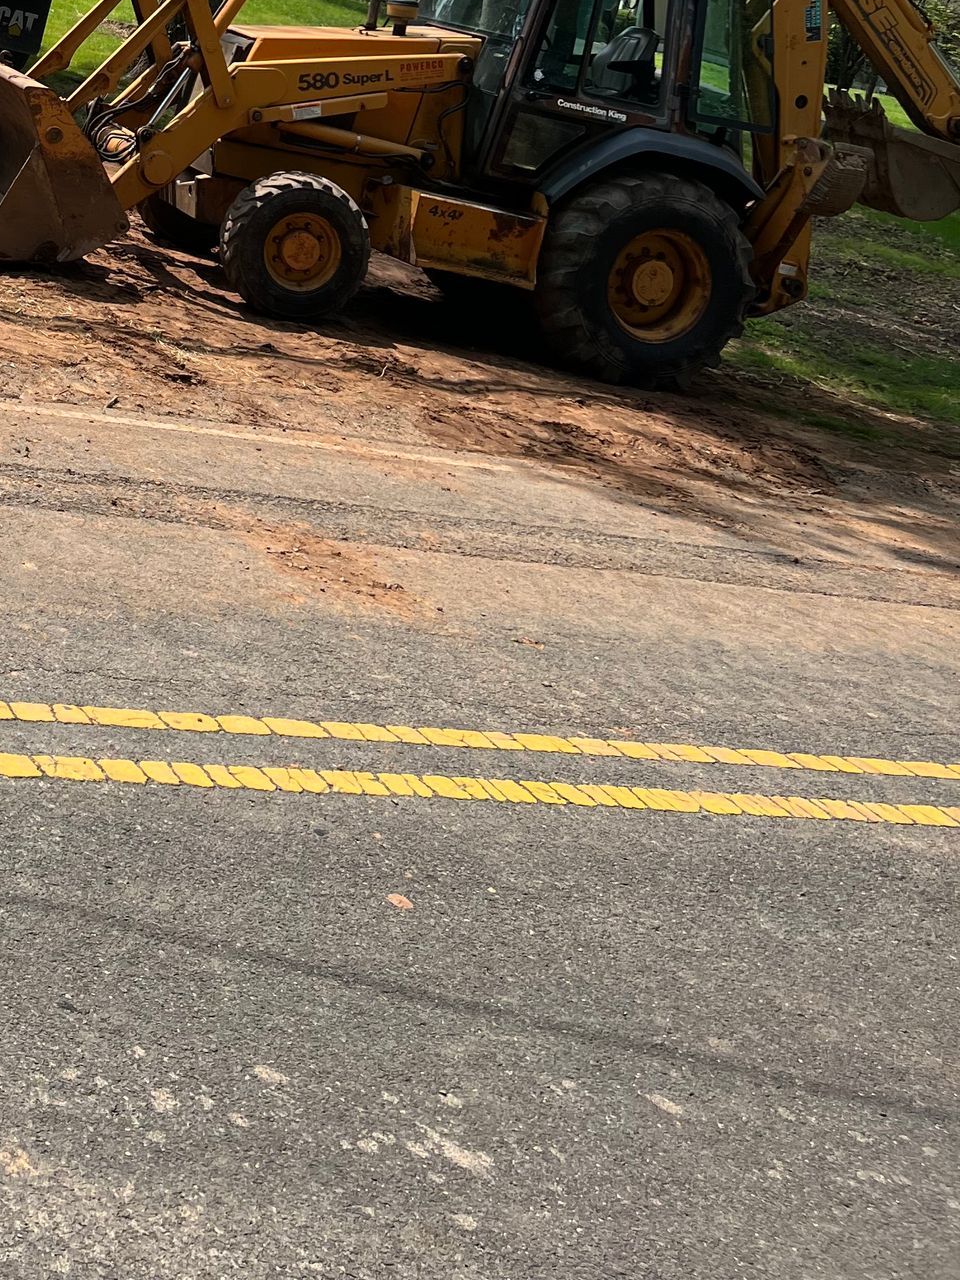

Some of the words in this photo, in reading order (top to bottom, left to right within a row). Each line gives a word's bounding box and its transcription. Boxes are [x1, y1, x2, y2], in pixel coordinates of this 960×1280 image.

[298, 72, 339, 91] 580
[343, 73, 383, 86] Super
[385, 70, 394, 81] L
[557, 99, 607, 116] Construction
[608, 109, 627, 121] King
